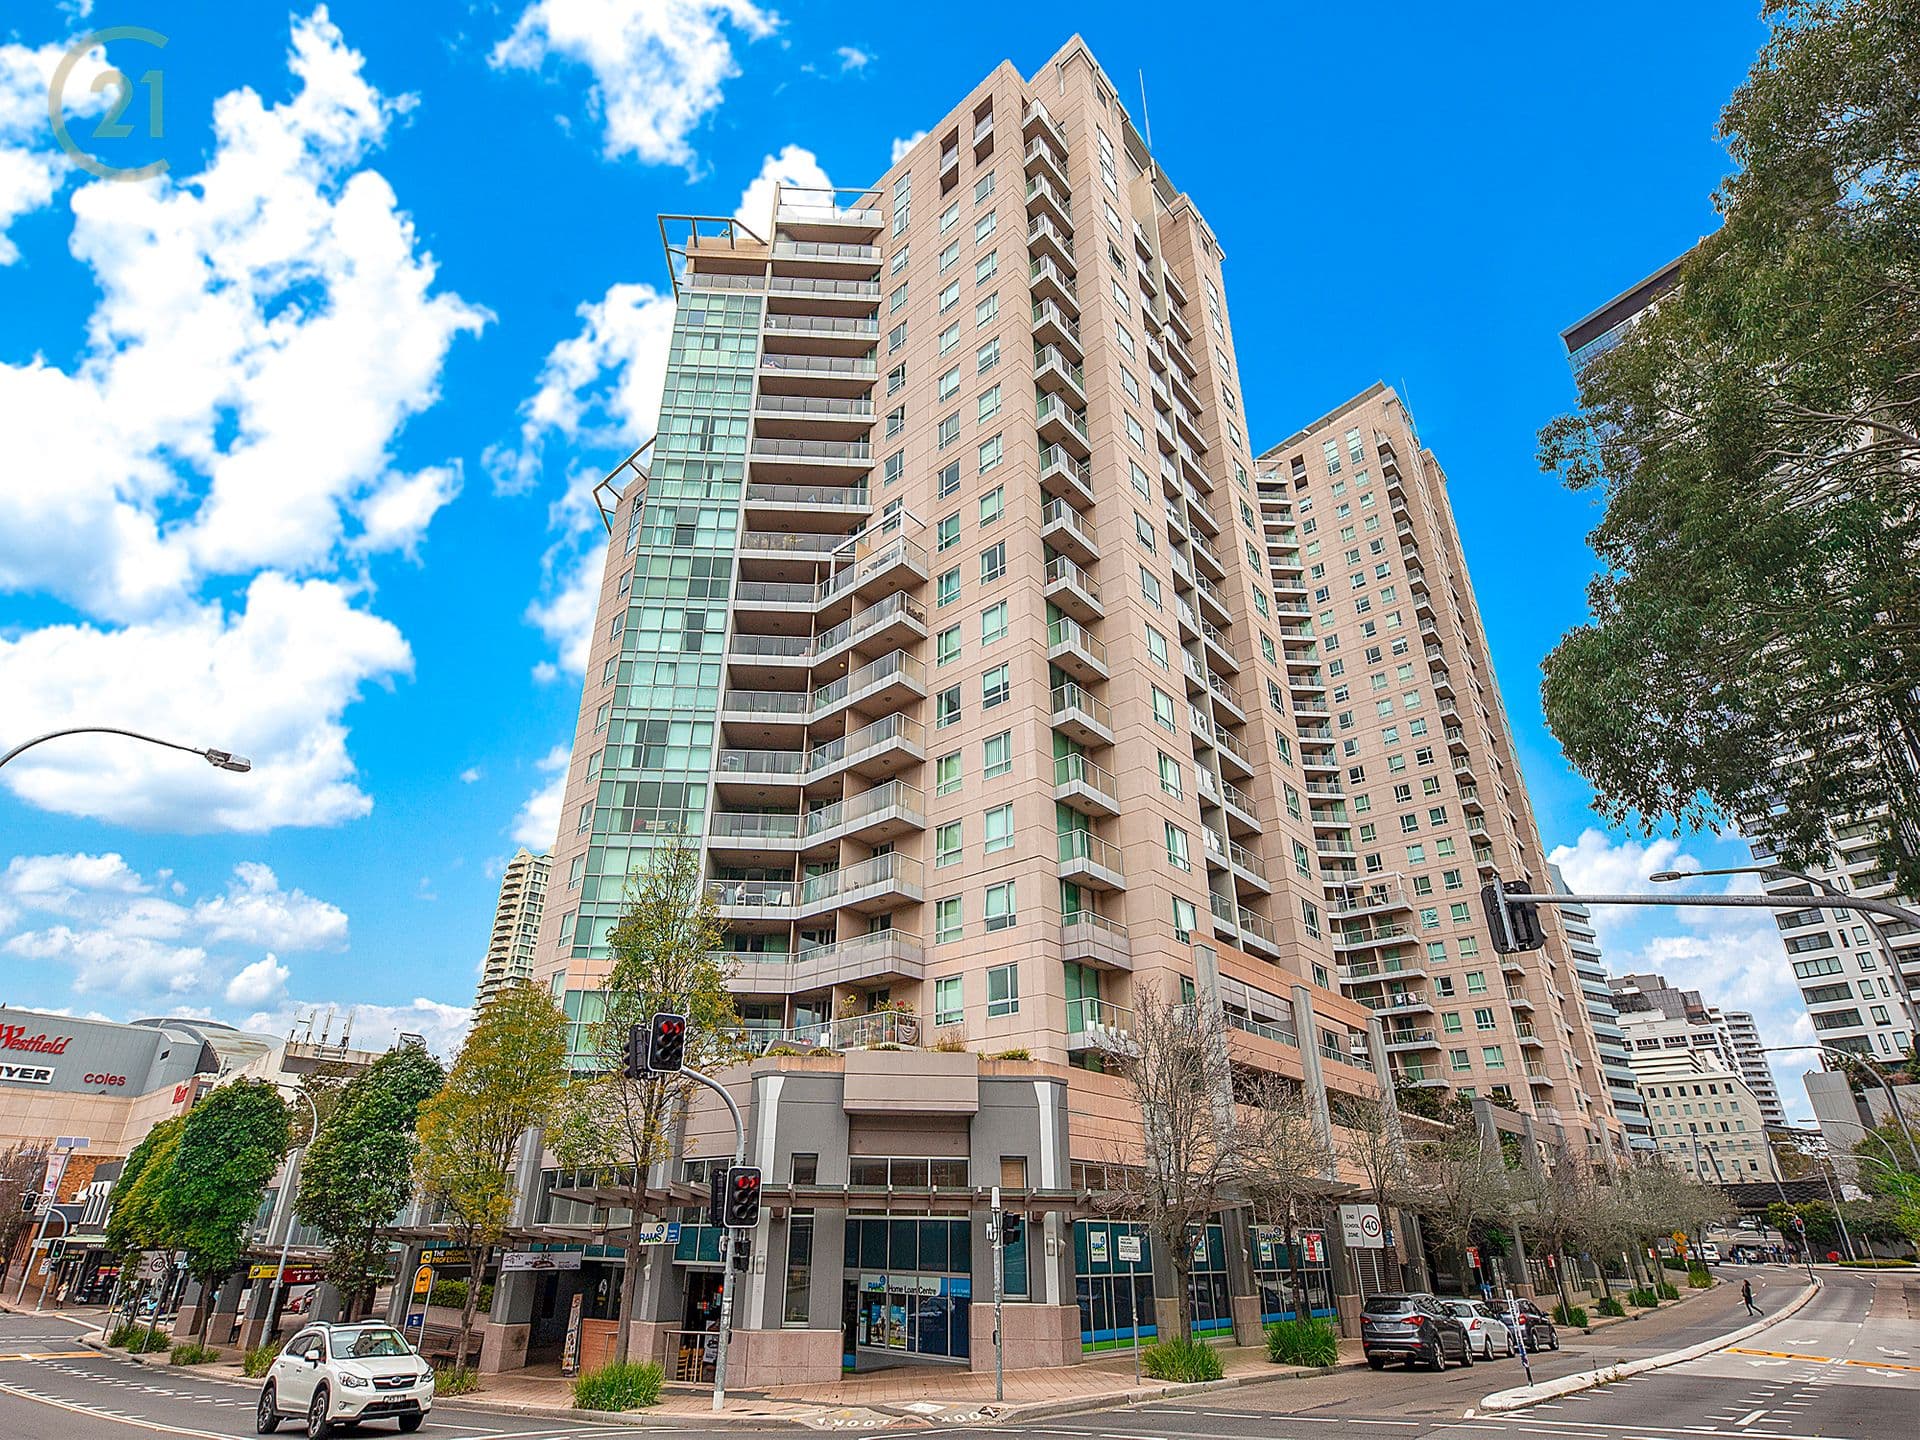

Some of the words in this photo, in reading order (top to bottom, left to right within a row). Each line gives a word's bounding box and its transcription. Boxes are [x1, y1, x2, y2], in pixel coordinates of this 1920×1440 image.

[0, 1023, 73, 1055] Westfield
[0, 1066, 51, 1080] YER
[84, 1072, 127, 1087] coles
[1365, 1220, 1378, 1231] 40
[639, 1232, 662, 1243] RAMS
[1260, 1232, 1281, 1242] RAMS
[889, 1284, 904, 1294] Home
[904, 1285, 917, 1295] Loan
[919, 1286, 937, 1296] Centre
